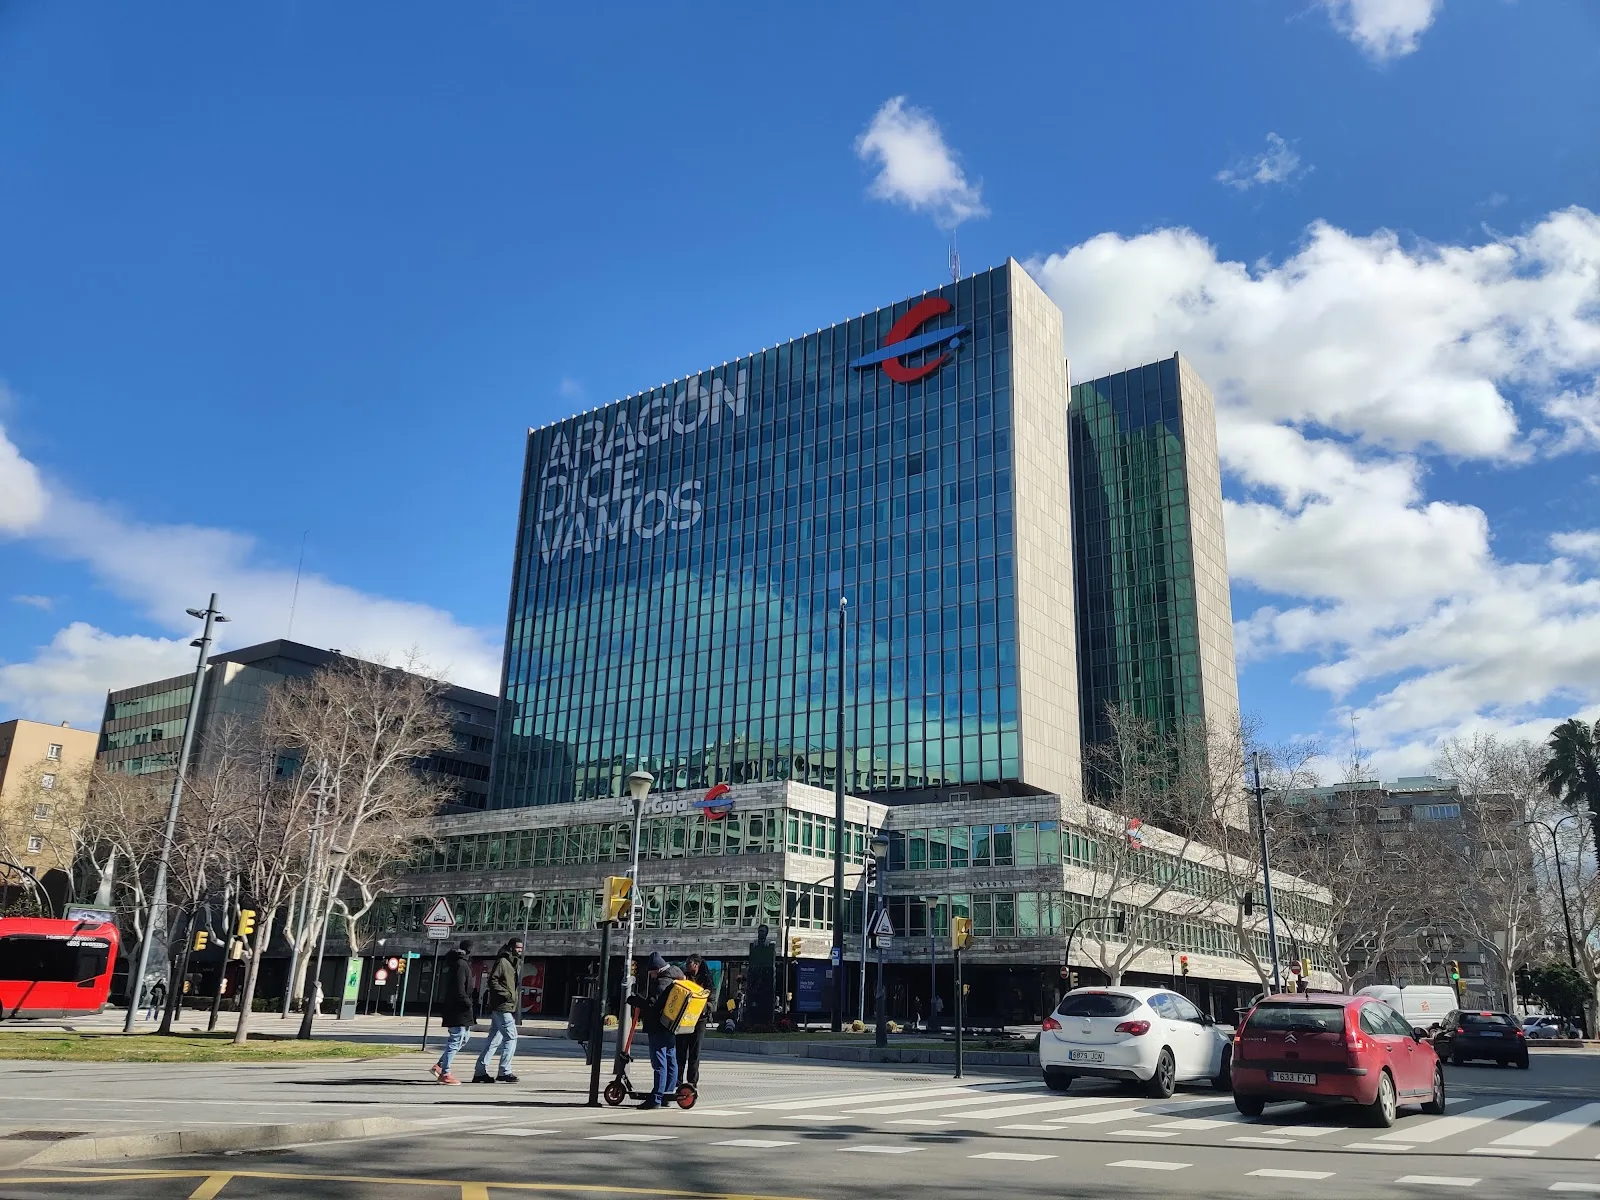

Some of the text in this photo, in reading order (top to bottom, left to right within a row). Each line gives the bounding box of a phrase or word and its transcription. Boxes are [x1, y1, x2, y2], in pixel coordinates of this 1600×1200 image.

[541, 368, 747, 479] ARAGÓN
[535, 479, 702, 565] VAMOS
[538, 449, 644, 523] DICE
[1276, 1072, 1312, 1083] 1633 FKT
